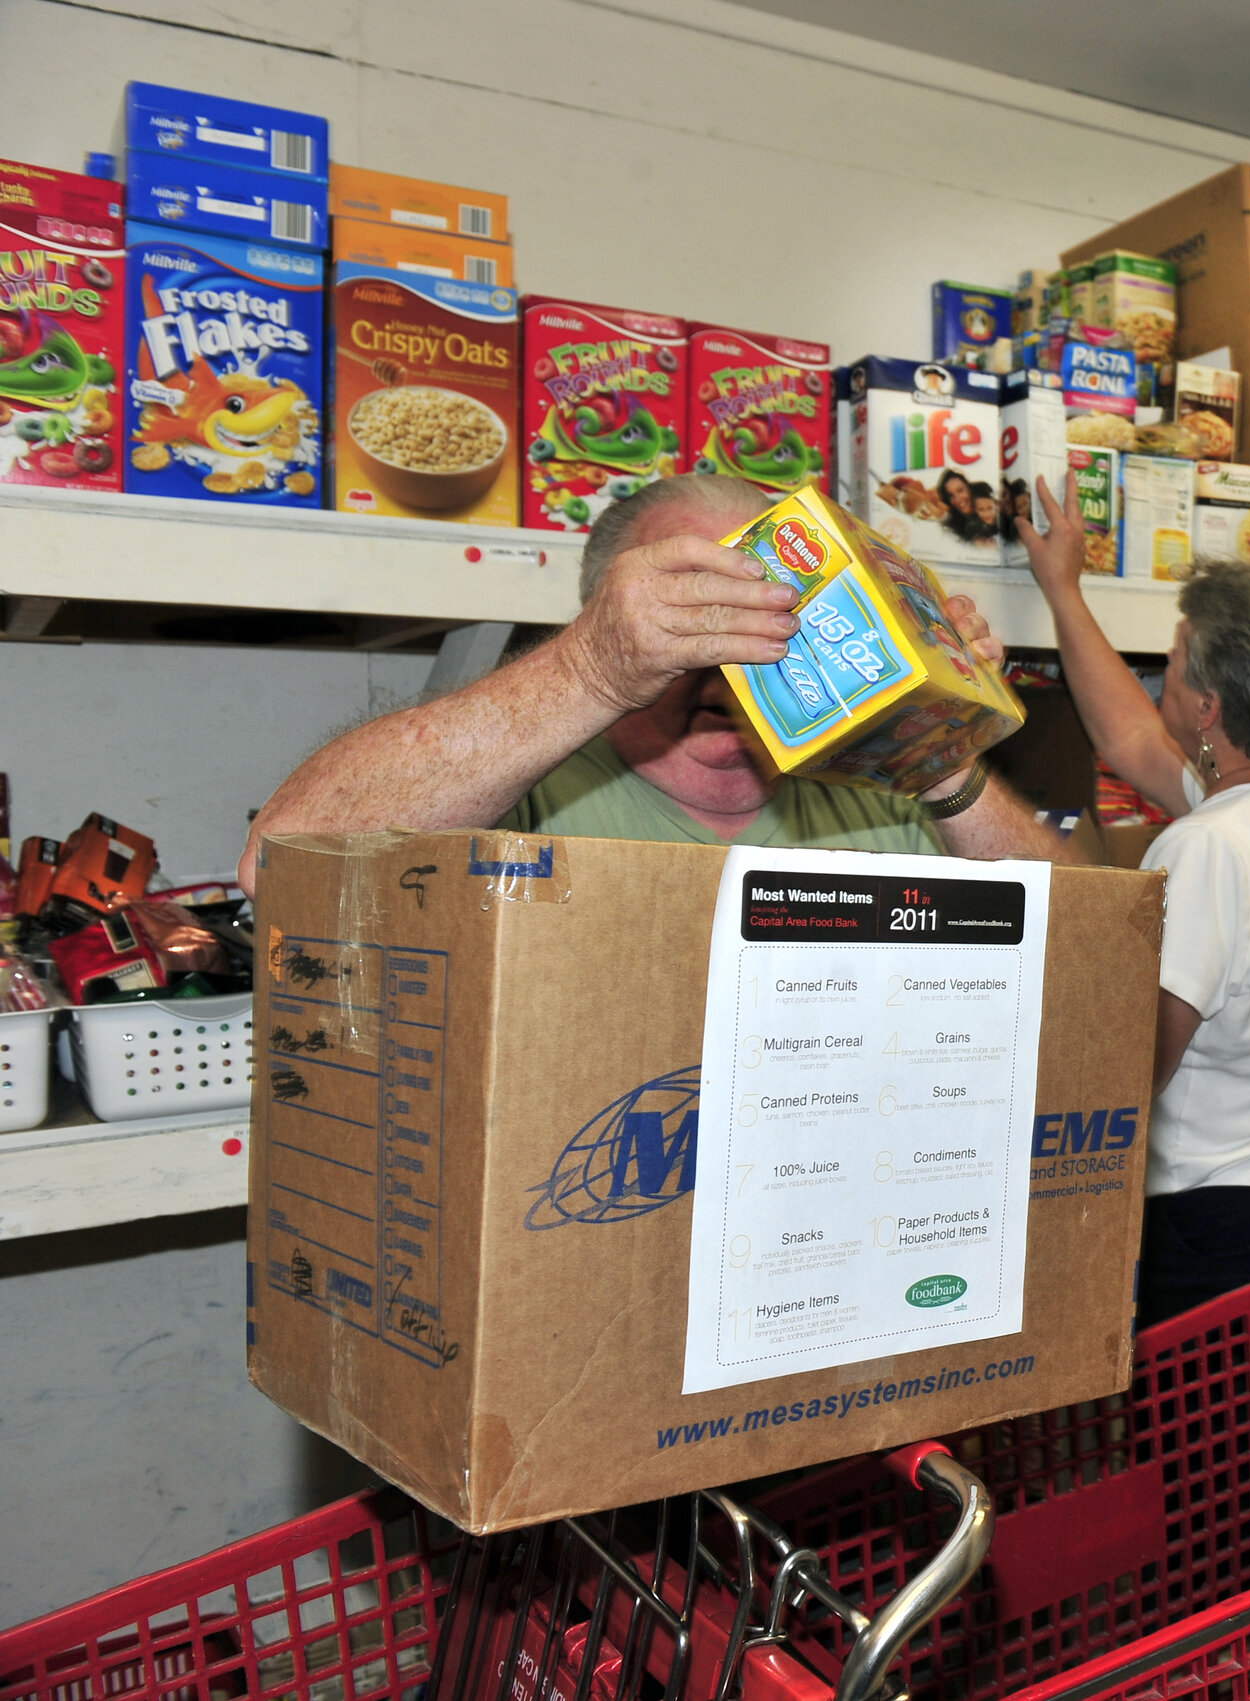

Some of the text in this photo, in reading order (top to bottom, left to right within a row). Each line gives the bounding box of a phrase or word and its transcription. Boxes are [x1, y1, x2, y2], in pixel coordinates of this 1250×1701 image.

[0, 249, 77, 285] UIT
[143, 251, 200, 273] Millville
[0, 281, 102, 317] UNDS
[158, 287, 290, 327] Frosted
[352, 286, 405, 307] Millville
[539, 313, 585, 331] Millville
[142, 310, 311, 380] Flakes
[351, 319, 510, 369] Crispy Oats
[548, 340, 653, 377] FRUIT
[1071, 346, 1132, 375] PASTA
[544, 367, 671, 420] ROUNDS
[710, 364, 803, 400] FRUIT
[1070, 369, 1128, 396] RONI
[707, 390, 817, 437] ROUNDS
[889, 408, 983, 473] life
[778, 522, 821, 570] Del Monte
[781, 545, 800, 566] Quality
[763, 554, 791, 582] Lite
[807, 600, 855, 644] 15
[812, 637, 851, 674] cans
[783, 650, 821, 710] Lite
[751, 888, 873, 905] Most Wanted Items
[903, 889, 919, 904] 11
[750, 915, 858, 929] Capital Area Food Bank
[889, 908, 938, 931] 2011
[775, 979, 858, 992] Canned Fruits
[903, 978, 1007, 993] Canned Vegetables
[764, 1035, 864, 1053] Multigrain Cereal
[935, 1032, 971, 1044] Grains
[760, 1092, 859, 1109] Canned Proteins
[932, 1086, 967, 1099] Soups
[913, 1147, 977, 1164] Condiments
[773, 1160, 840, 1178] 100% Juice
[1029, 1154, 1126, 1181] and STORAGE
[1028, 1180, 1125, 1201] ommercial Logistics
[897, 1207, 990, 1230] Paper Products &
[781, 1229, 824, 1245] Snacks
[899, 1224, 988, 1246] Household Items
[911, 1281, 963, 1301] foodbank
[920, 1277, 951, 1287] capital area
[756, 1293, 840, 1319] Hygiene Items
[655, 1351, 1036, 1451] www.mesasystemsinc.com
